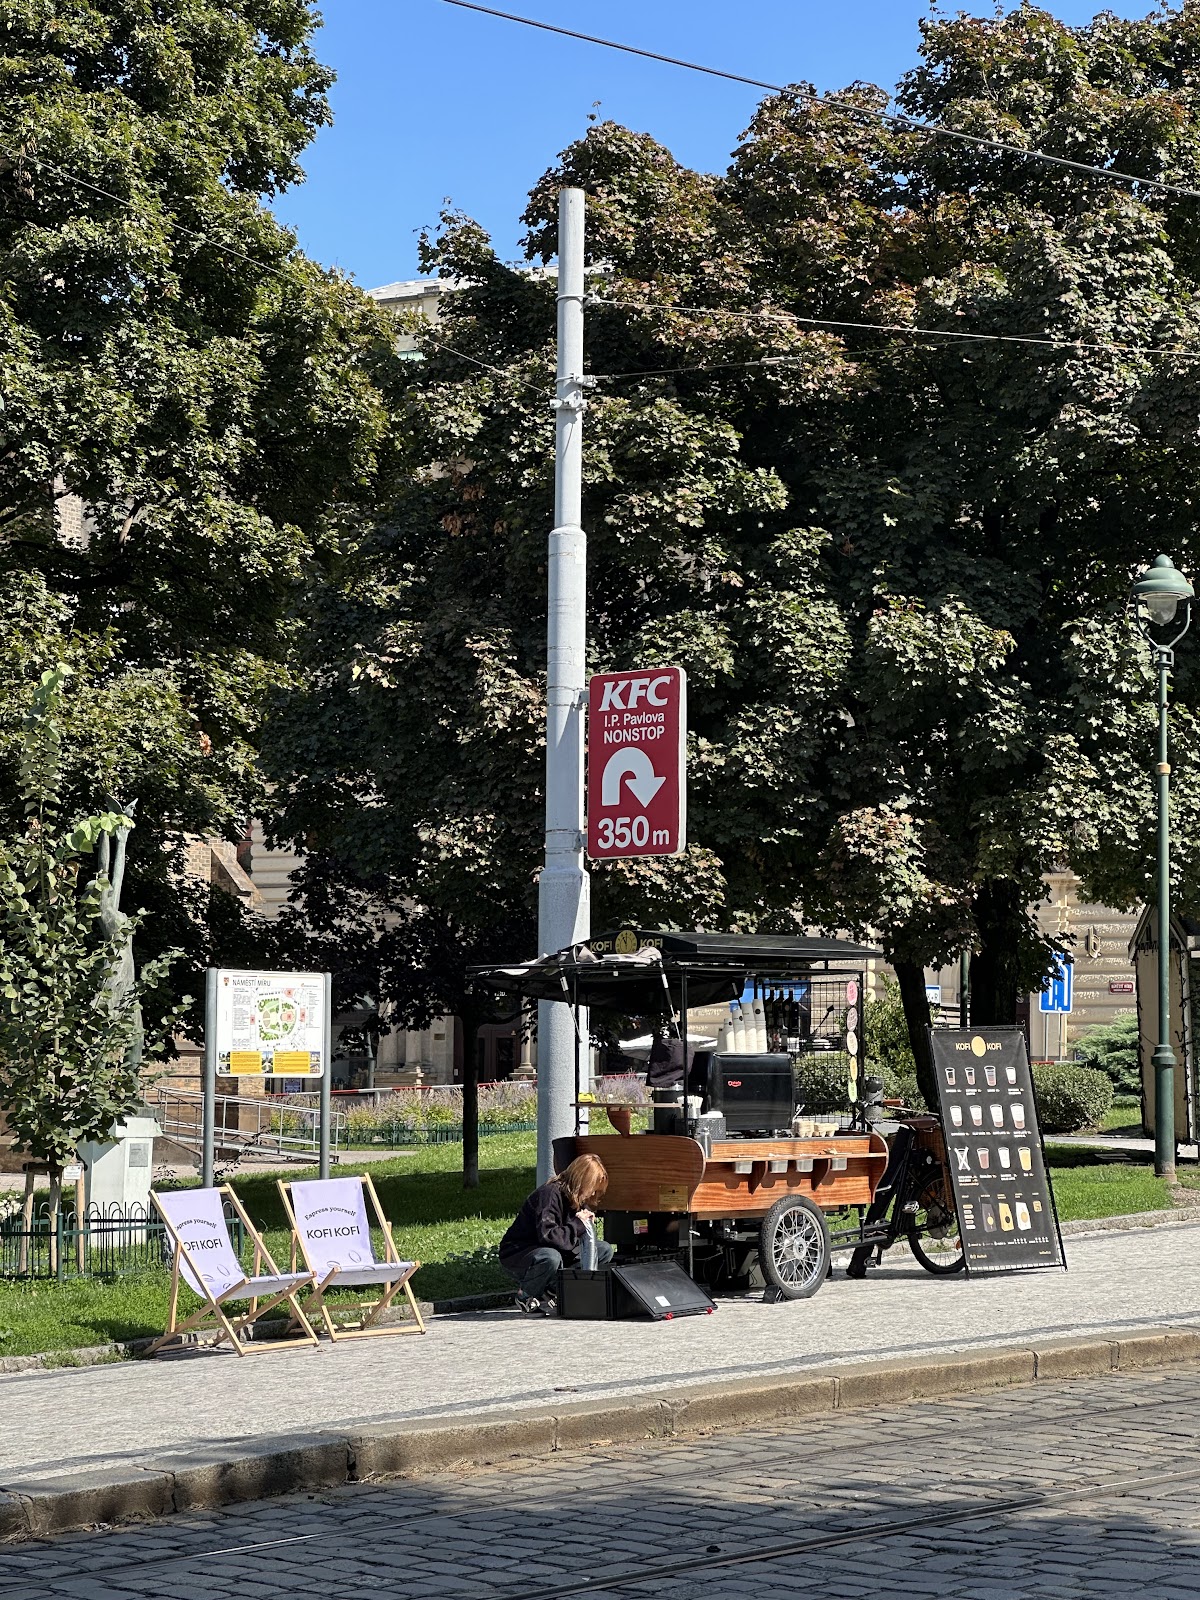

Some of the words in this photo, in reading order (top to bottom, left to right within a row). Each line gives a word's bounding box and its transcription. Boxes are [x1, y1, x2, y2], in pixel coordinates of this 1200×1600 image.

[598, 675, 671, 711] KFC
[604, 714, 620, 728] I.P.
[623, 711, 665, 726] Pavlova
[603, 725, 665, 744] NONSTOP
[597, 815, 650, 849] 350
[652, 828, 670, 846] m
[589, 940, 613, 952] KOFI
[640, 938, 663, 949] KOFI
[955, 1042, 971, 1051] KOFI
[986, 1042, 1002, 1051] KOFI
[329, 1206, 356, 1217] yourself
[176, 1219, 193, 1231] spress
[193, 1218, 217, 1229] yourself
[306, 1228, 333, 1239] KOFI
[333, 1225, 361, 1237] KOFI
[183, 1240, 200, 1251] OFI
[199, 1238, 223, 1250] KOFI
